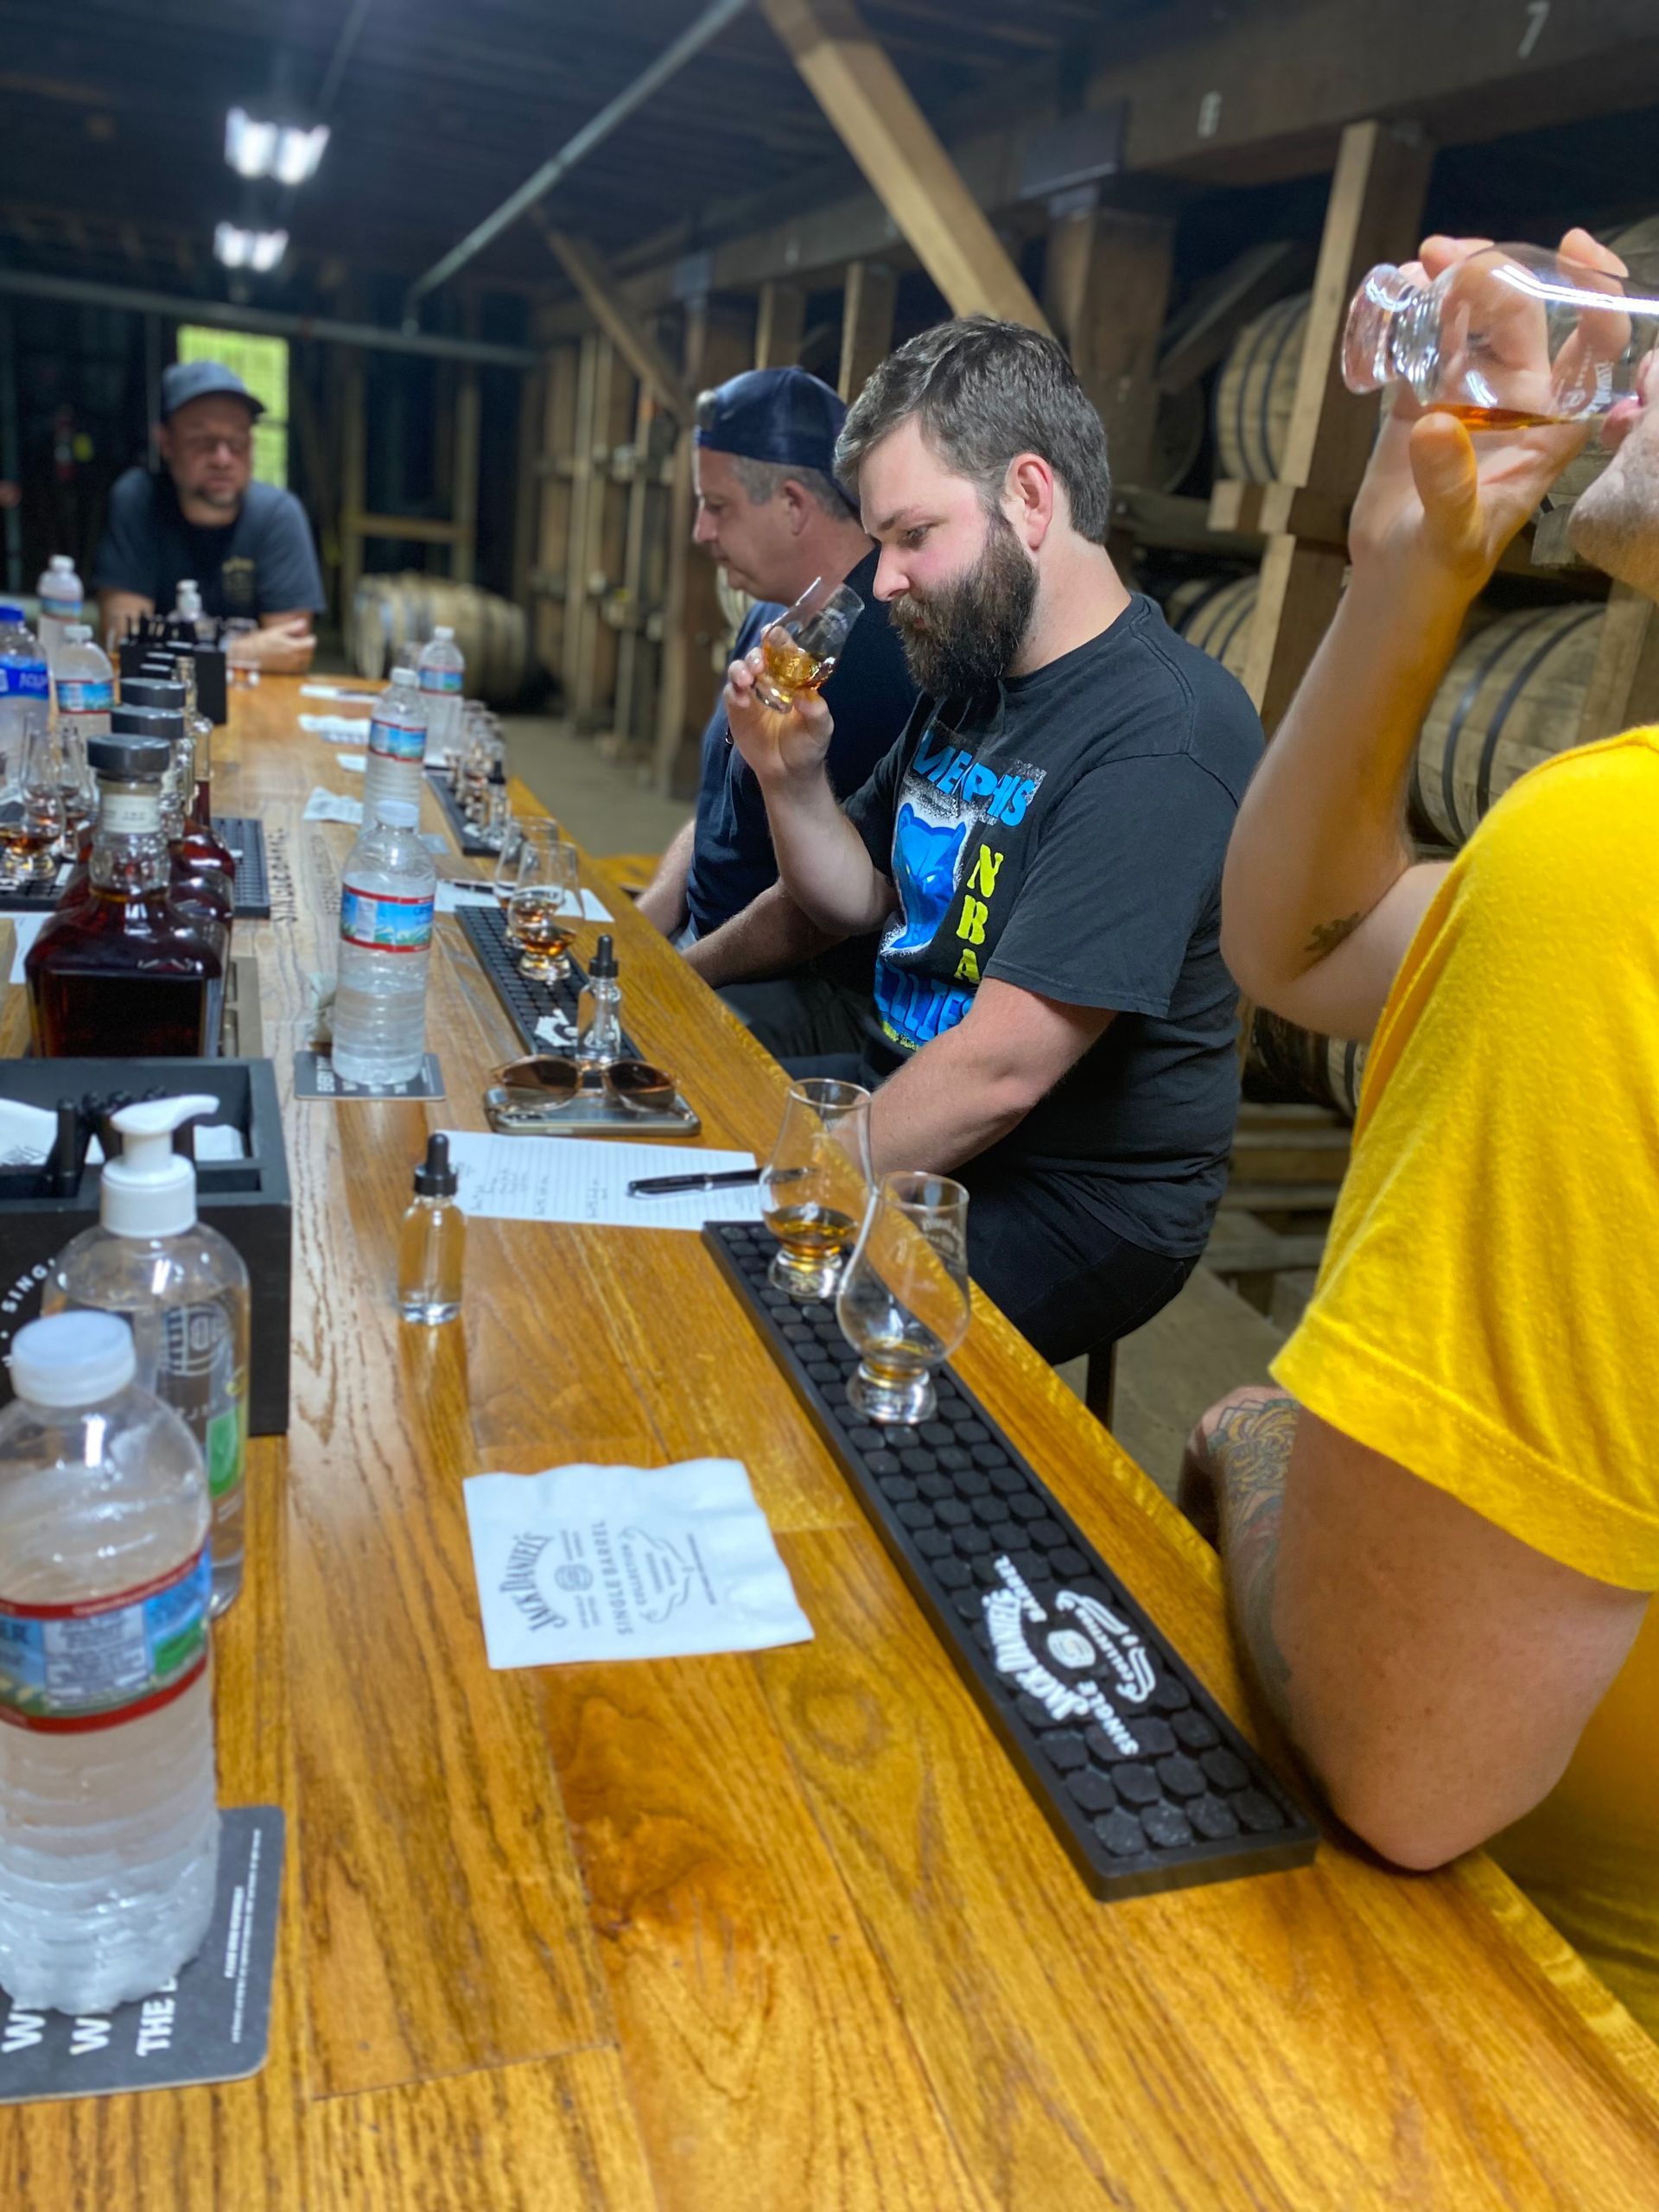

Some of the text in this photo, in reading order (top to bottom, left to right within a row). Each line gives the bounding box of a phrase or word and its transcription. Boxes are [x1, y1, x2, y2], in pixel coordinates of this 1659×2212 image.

[912, 728, 1036, 828] MEPHIS
[1, 1257, 56, 1314] SING
[512, 1585, 569, 1632] JACK
[591, 1521, 635, 1637] SINGLE BARREL
[995, 1554, 1139, 1756] SINGLE BARREL
[1016, 1664, 1090, 1720] JACK
[136, 1997, 177, 2058] THE
